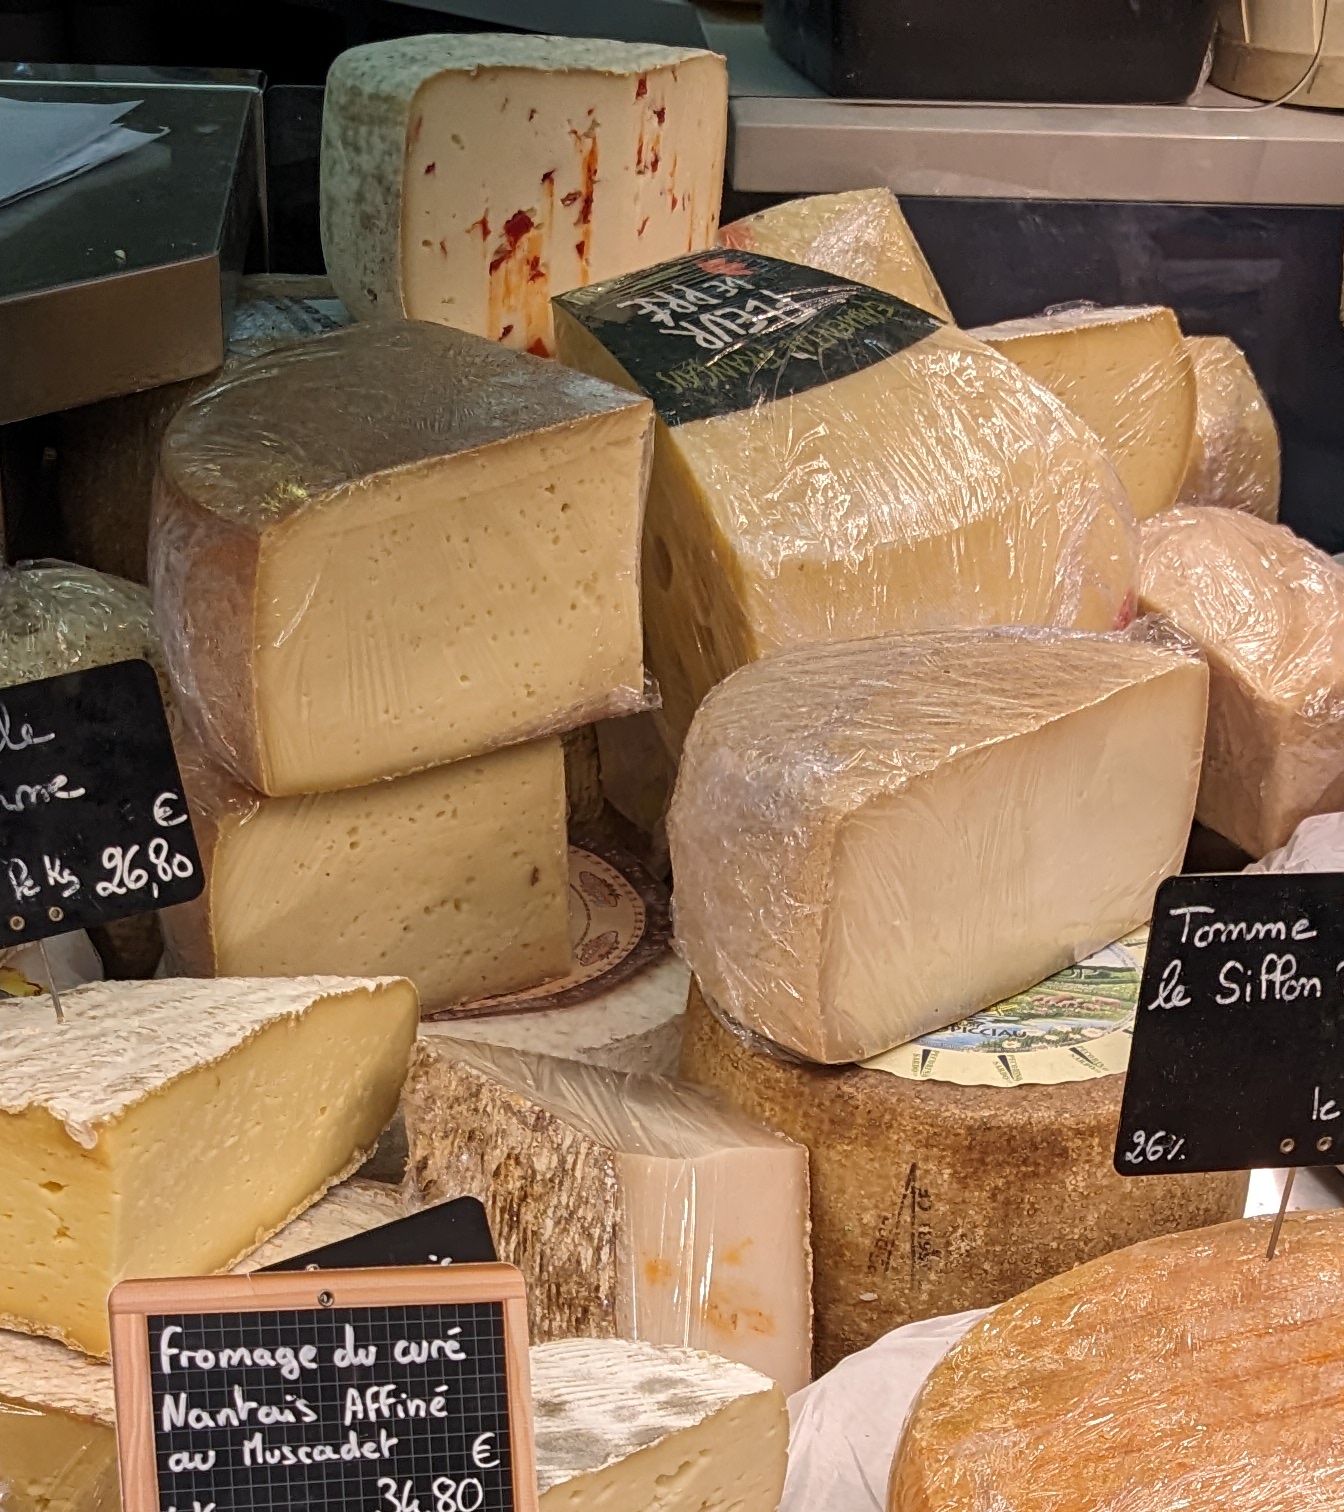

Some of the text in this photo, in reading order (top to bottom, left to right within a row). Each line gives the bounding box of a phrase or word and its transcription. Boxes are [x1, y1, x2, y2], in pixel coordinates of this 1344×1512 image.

[154, 791, 188, 827] €
[96, 837, 194, 898] 26,80
[1169, 905, 1317, 949] Tomme
[1148, 958, 1192, 1011] le
[334, 1323, 377, 1368] du
[394, 1326, 467, 1366] curé
[162, 1384, 318, 1432] Nantais
[169, 1428, 500, 1472] au Muscadet €
